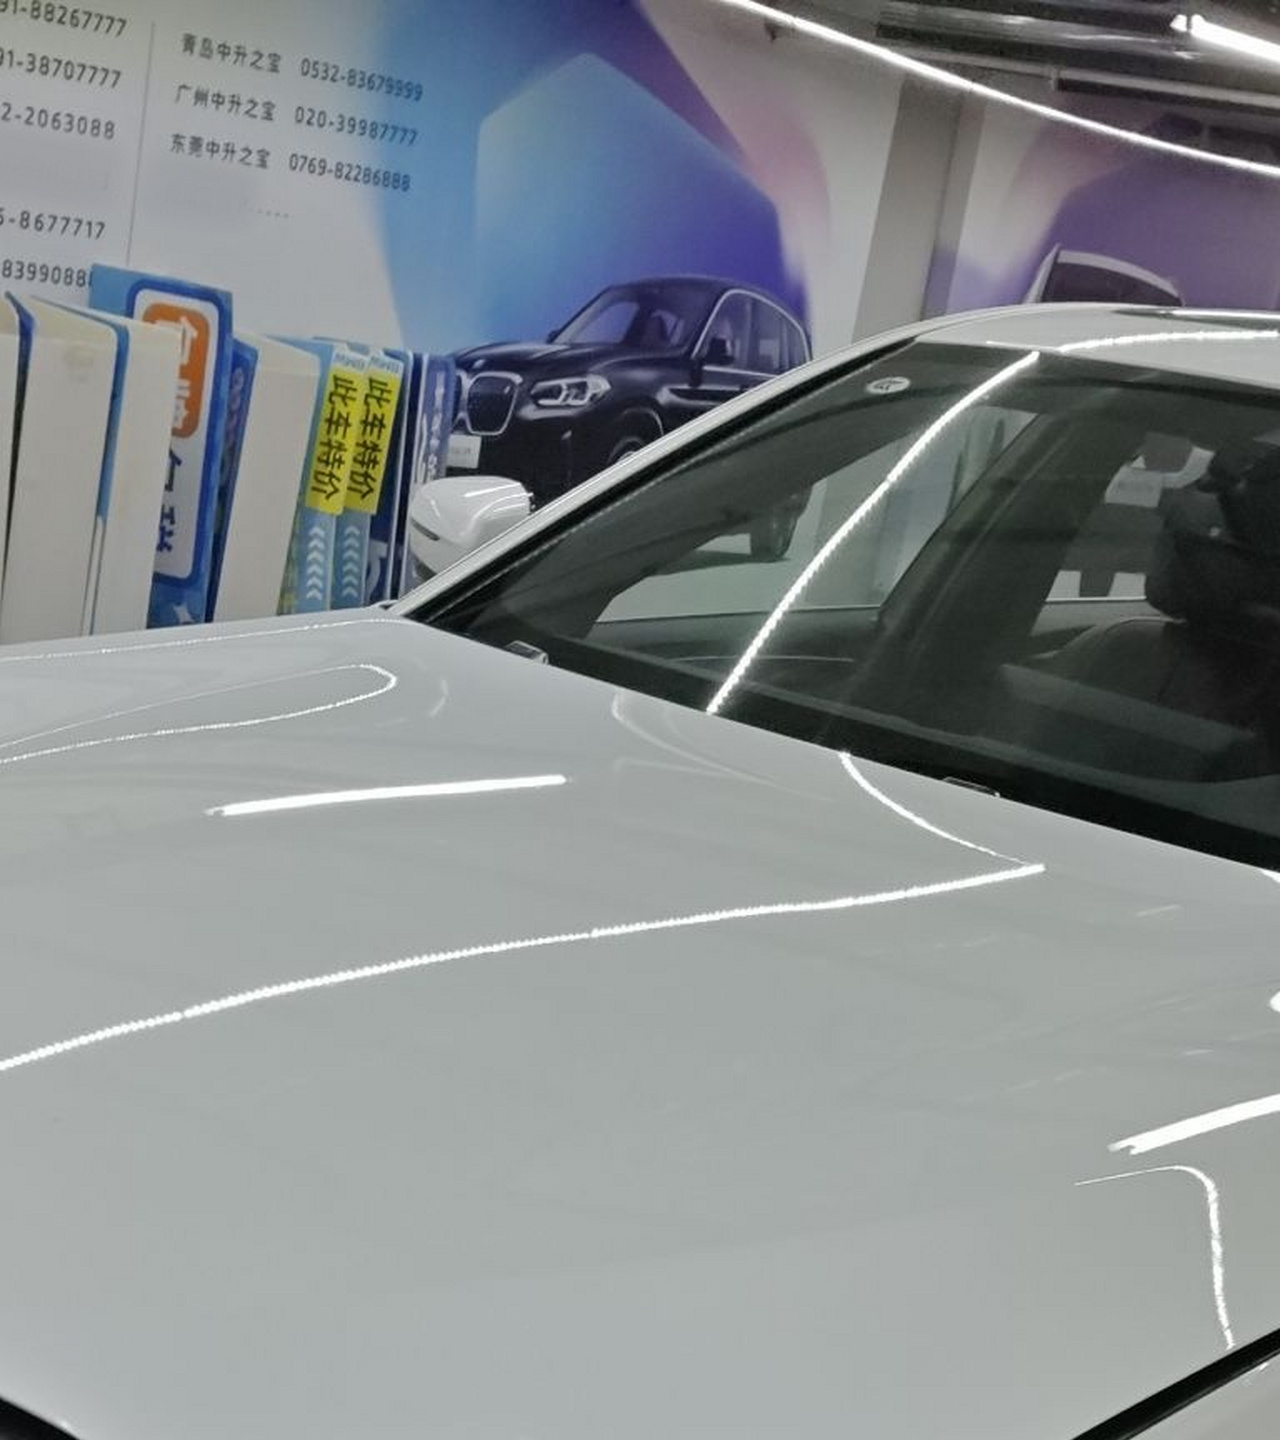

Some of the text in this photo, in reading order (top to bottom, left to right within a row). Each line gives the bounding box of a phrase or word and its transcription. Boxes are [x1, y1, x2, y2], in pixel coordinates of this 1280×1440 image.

[295, 106, 418, 146] 020-39987777
[289, 153, 410, 192] 0769-82286888
[312, 375, 357, 499] 此车特价
[348, 377, 393, 499] 此车特价
